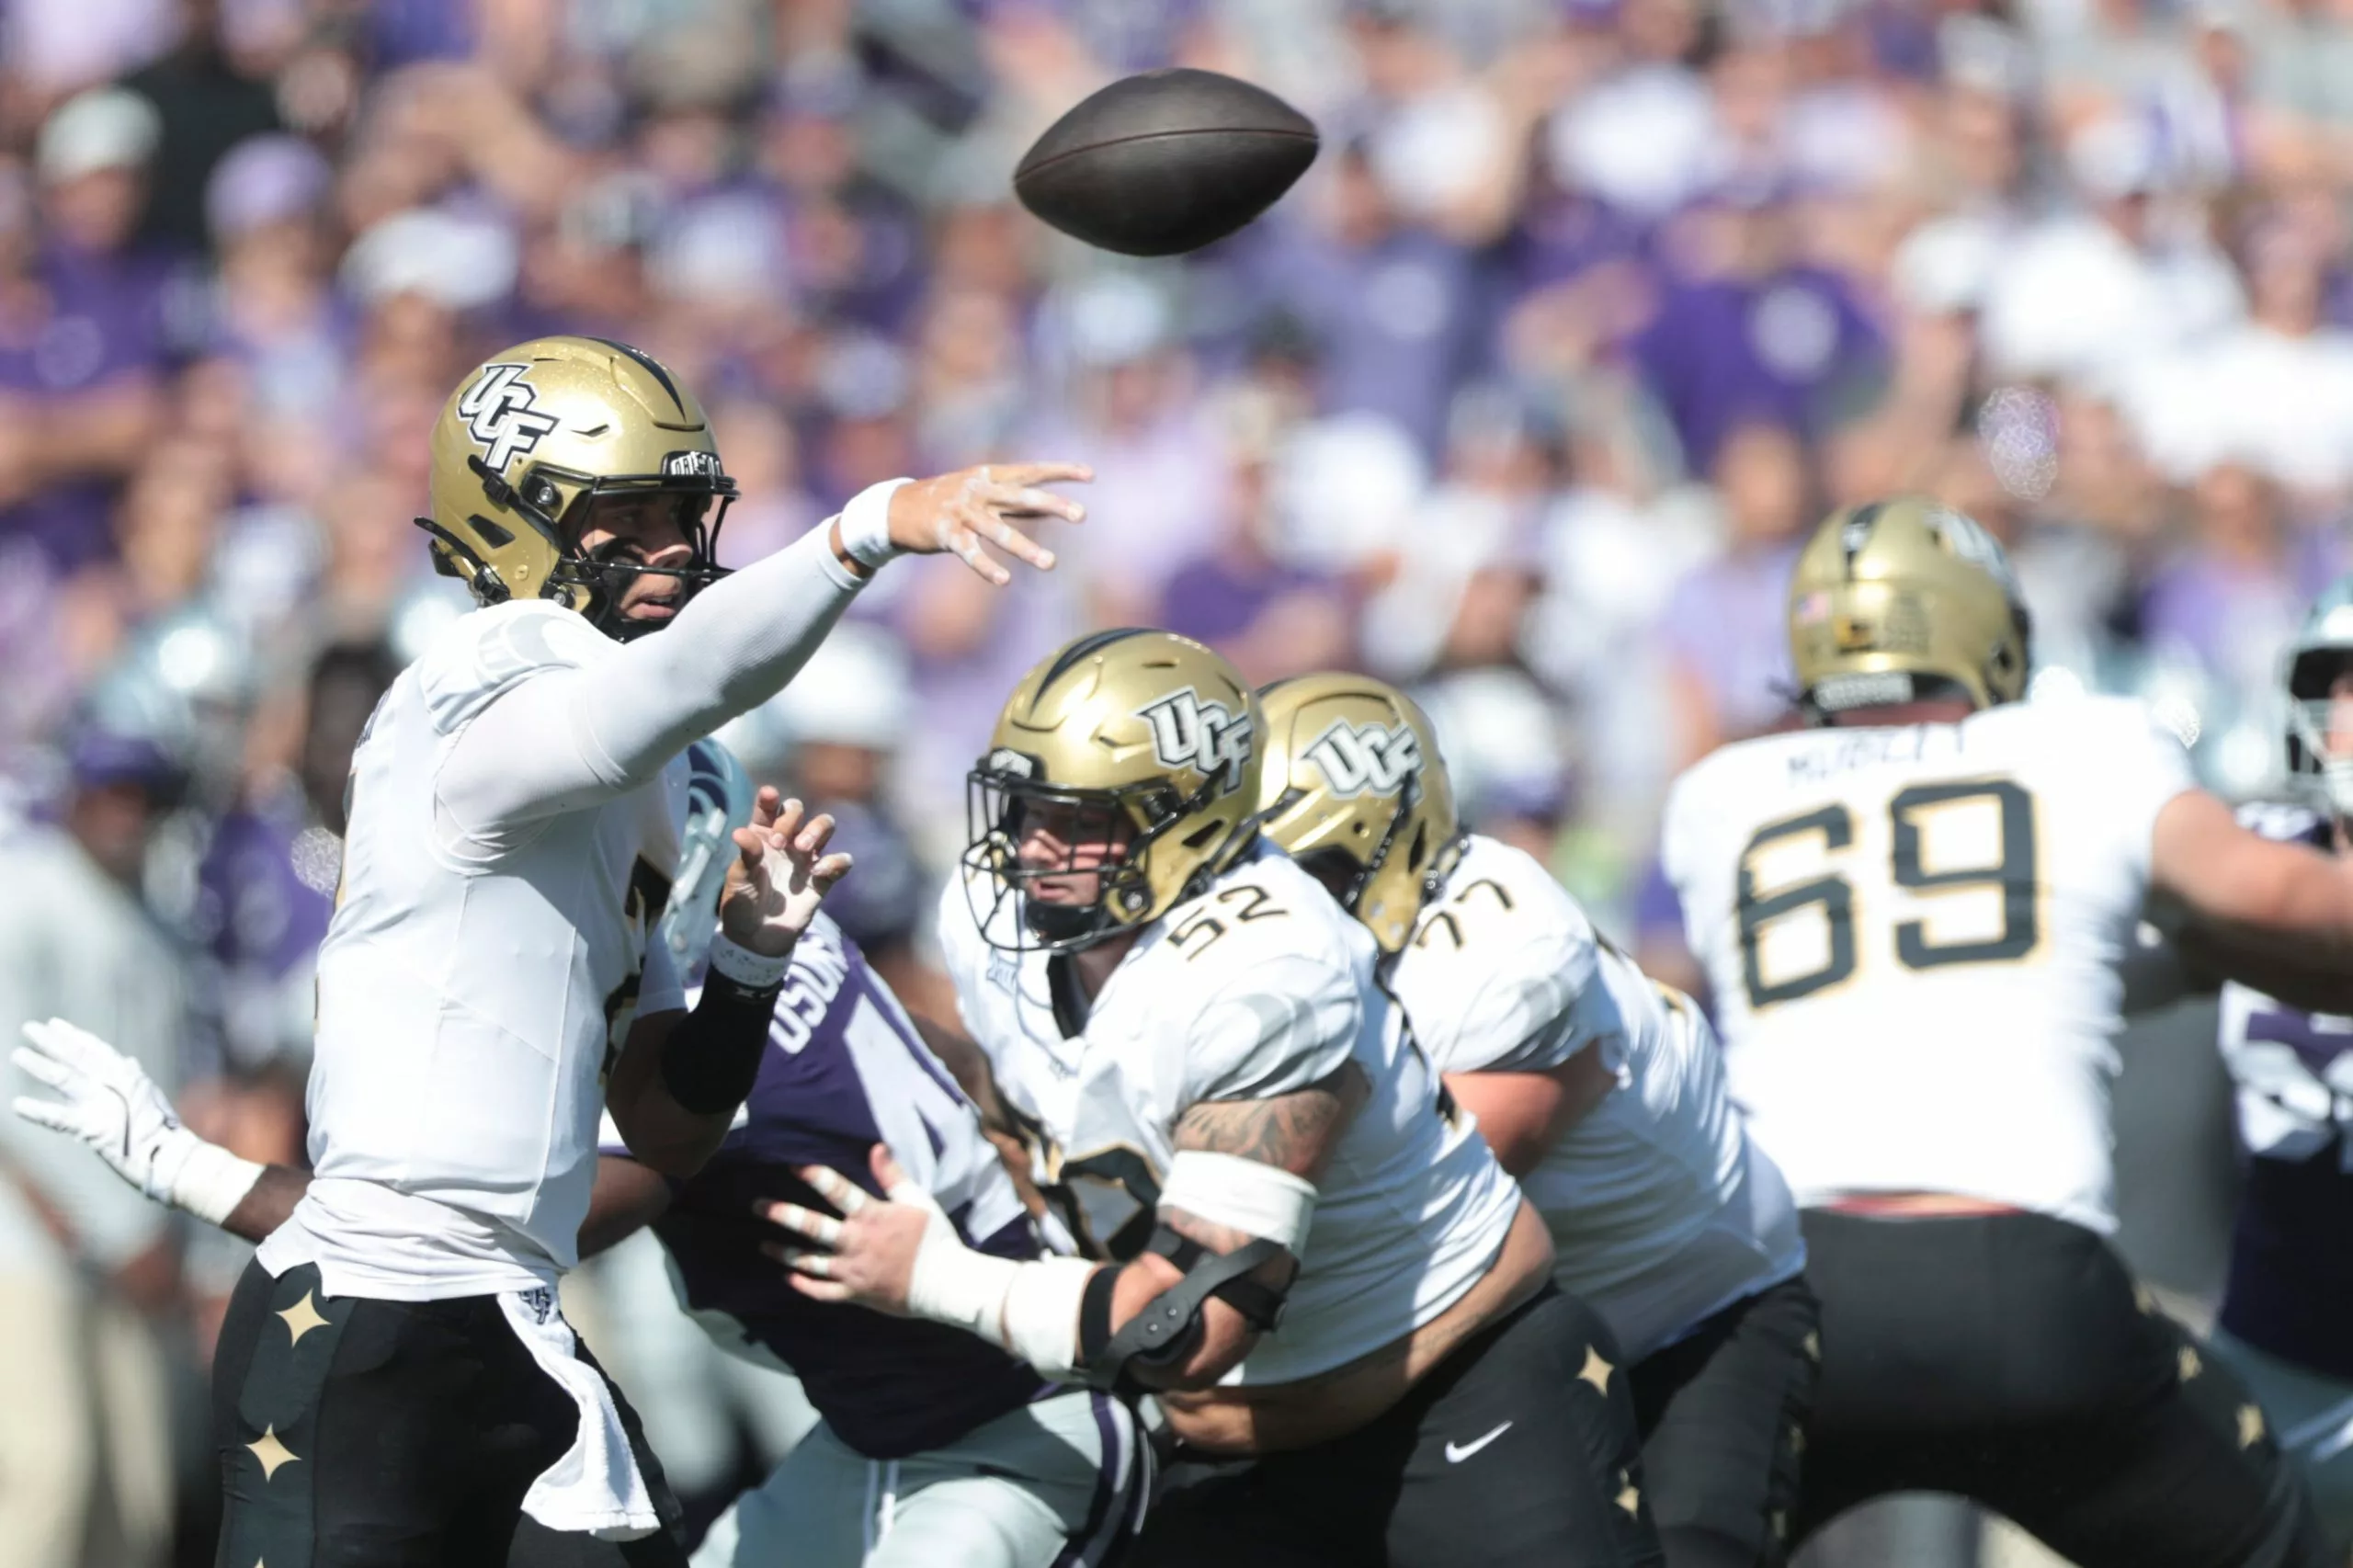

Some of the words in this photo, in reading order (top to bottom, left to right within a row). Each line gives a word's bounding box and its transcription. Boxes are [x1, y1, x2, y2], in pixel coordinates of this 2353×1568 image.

[459, 363, 559, 474] UCF
[1136, 689, 1252, 795] UCF
[1302, 721, 1426, 807] UCF
[1166, 884, 1289, 962] 52
[1415, 878, 1514, 949] 77
[1737, 779, 2037, 1011] 69
